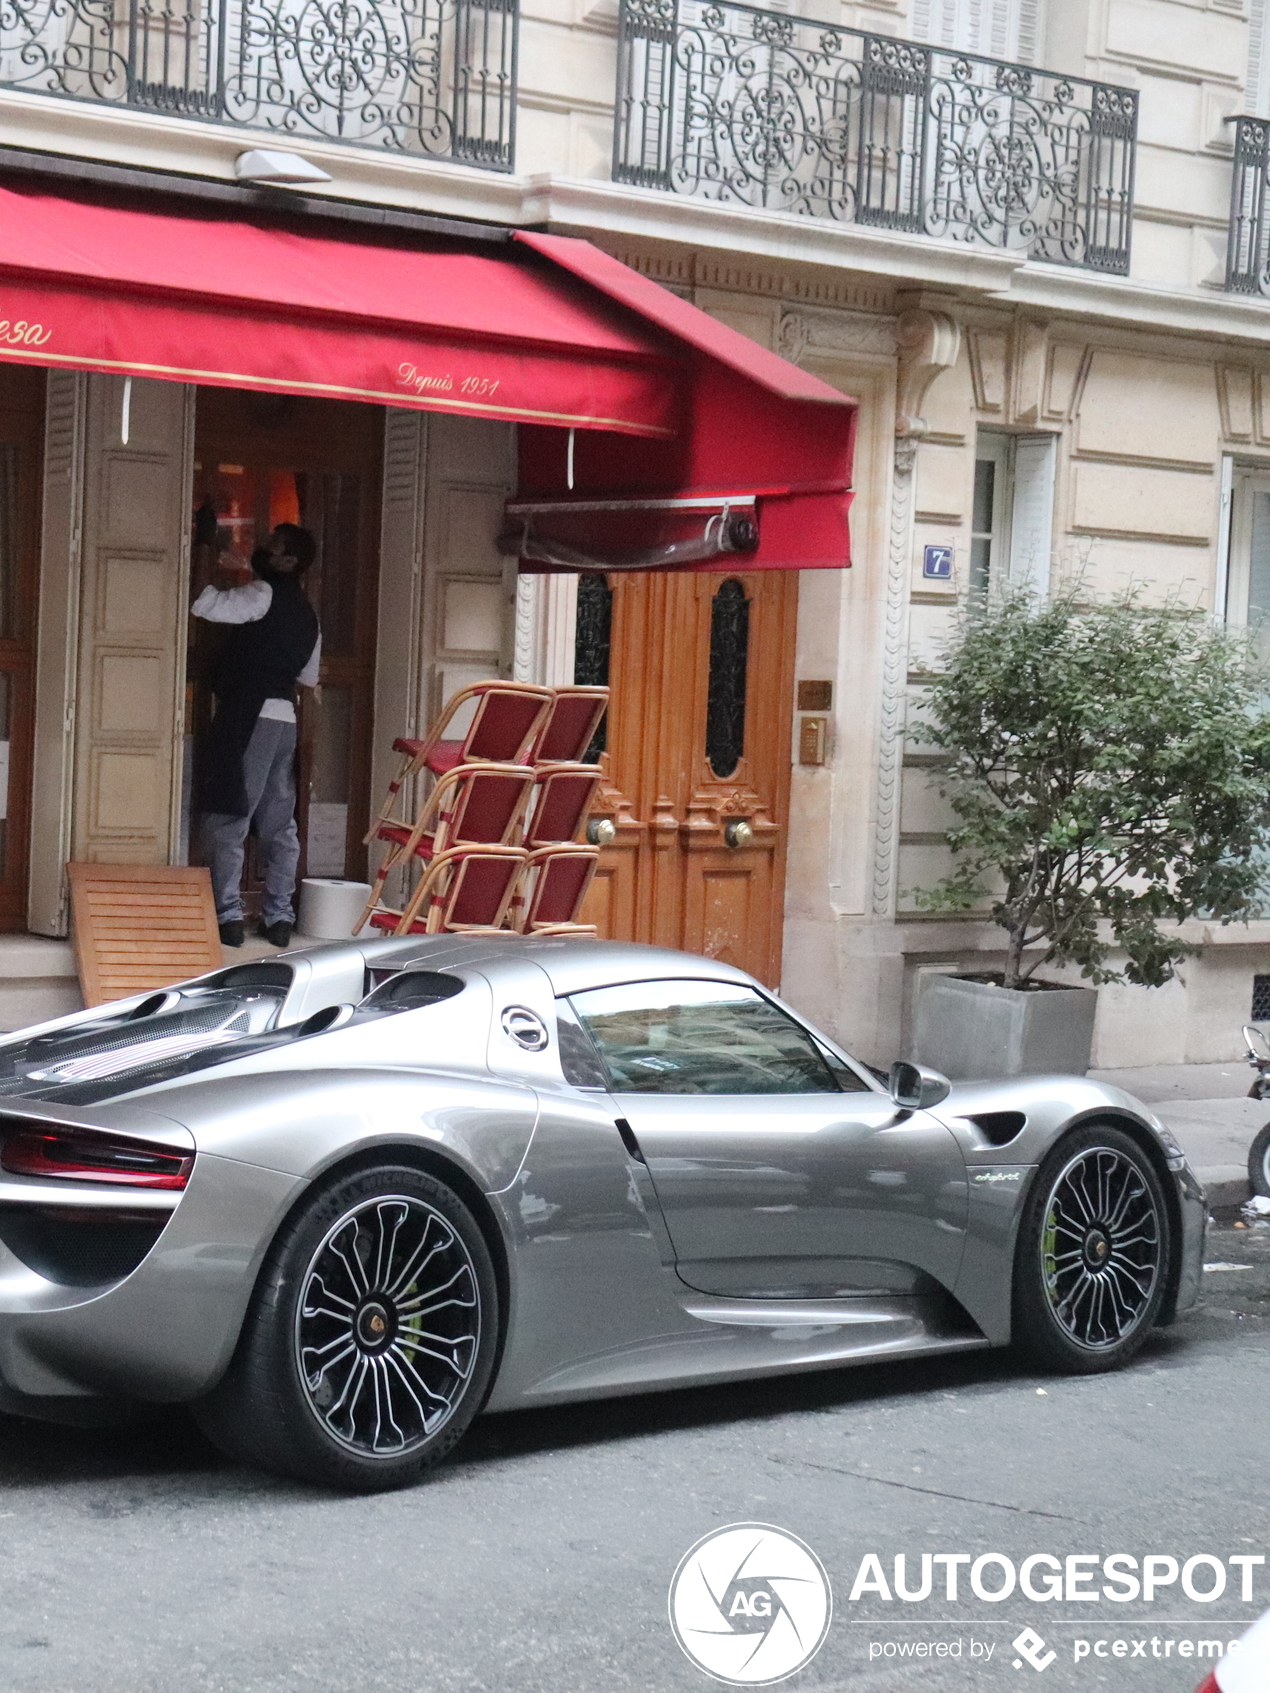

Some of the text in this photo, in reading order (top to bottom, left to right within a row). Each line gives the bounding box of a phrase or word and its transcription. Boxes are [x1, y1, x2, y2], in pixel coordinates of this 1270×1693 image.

[396, 362, 500, 396] Depuis 1951
[932, 550, 945, 574] 7
